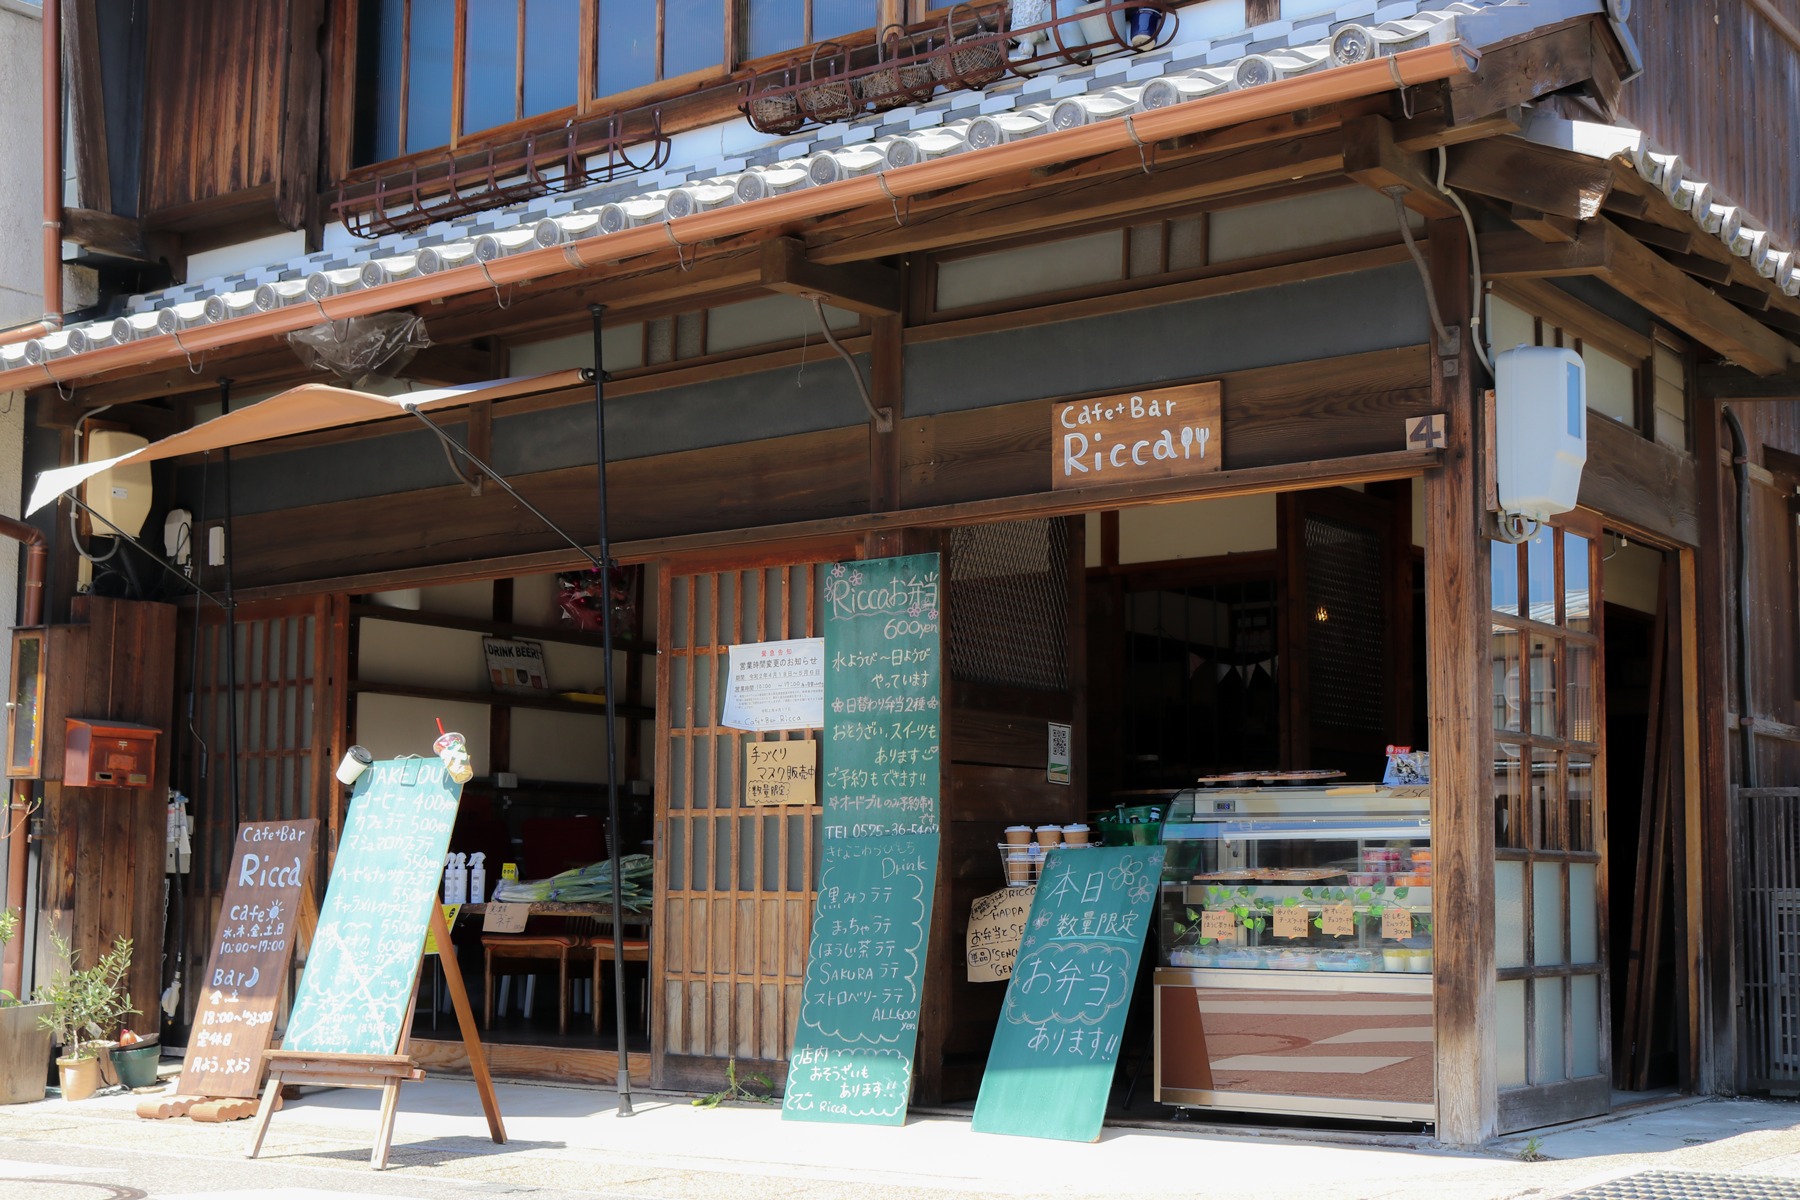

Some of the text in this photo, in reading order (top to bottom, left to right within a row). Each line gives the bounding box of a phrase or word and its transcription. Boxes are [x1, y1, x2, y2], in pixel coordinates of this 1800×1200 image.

[1409, 415, 1442, 448] 4
[1064, 429, 1178, 476] Ricca
[488, 644, 514, 657] DRINK
[871, 670, 929, 689] やっています
[751, 747, 787, 764] 手づくり
[875, 746, 920, 765] あります
[366, 766, 412, 784] TAKE
[757, 765, 816, 781] マスク販売中
[357, 792, 405, 809] コーヒー
[355, 811, 405, 831] カフェラテ
[238, 853, 303, 888] Ricca
[882, 856, 928, 879] Drink
[1045, 864, 1105, 908] 本日
[1056, 911, 1139, 937] 数量限定
[212, 968, 245, 987] Bar
[1022, 957, 1113, 1006] お弁当
[798, 1044, 828, 1064] 店内
[819, 1101, 847, 1114] Ricca
